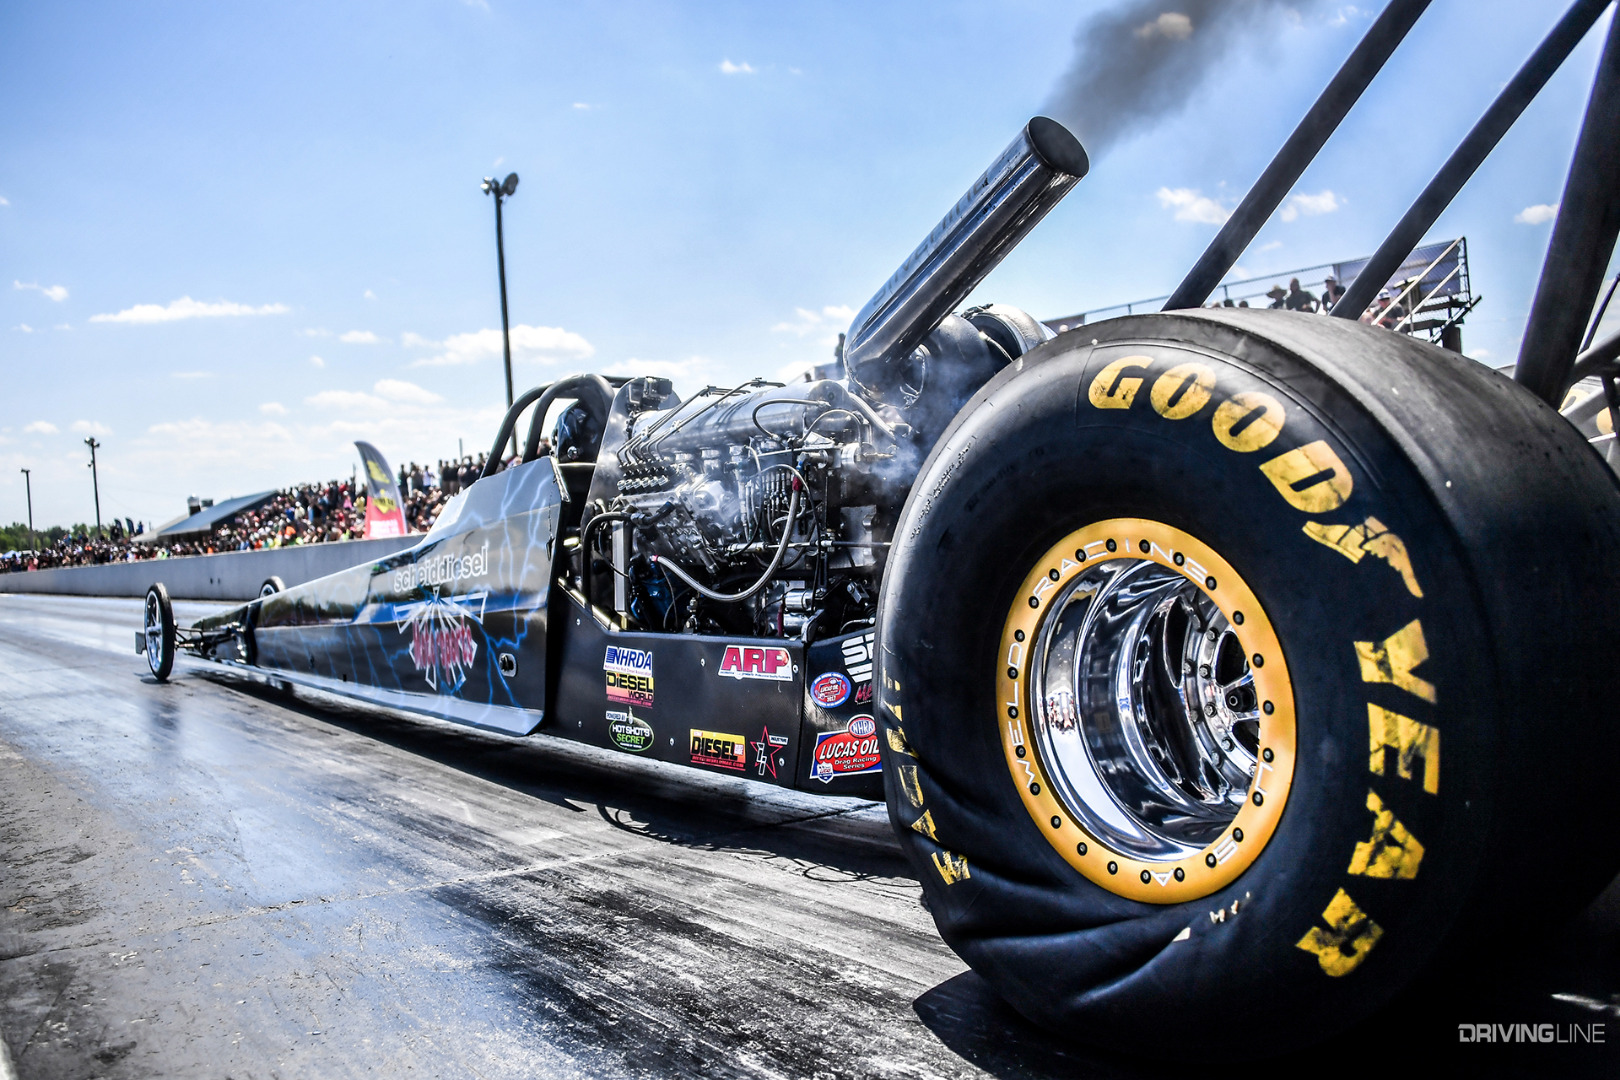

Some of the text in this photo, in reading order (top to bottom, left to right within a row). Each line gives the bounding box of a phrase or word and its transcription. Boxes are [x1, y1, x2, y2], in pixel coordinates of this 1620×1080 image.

[607, 648, 652, 671] NHRDA
[721, 647, 789, 674] ARP
[1006, 537, 1208, 790] WELD RACING
[627, 690, 654, 702] WORLD
[612, 724, 625, 734] HOT
[851, 720, 874, 735] NHRA
[616, 733, 645, 745] SECRET
[692, 736, 738, 761] DIESEL
[819, 739, 880, 760] LUCAS OIL
[834, 756, 877, 766] Drag Racing
